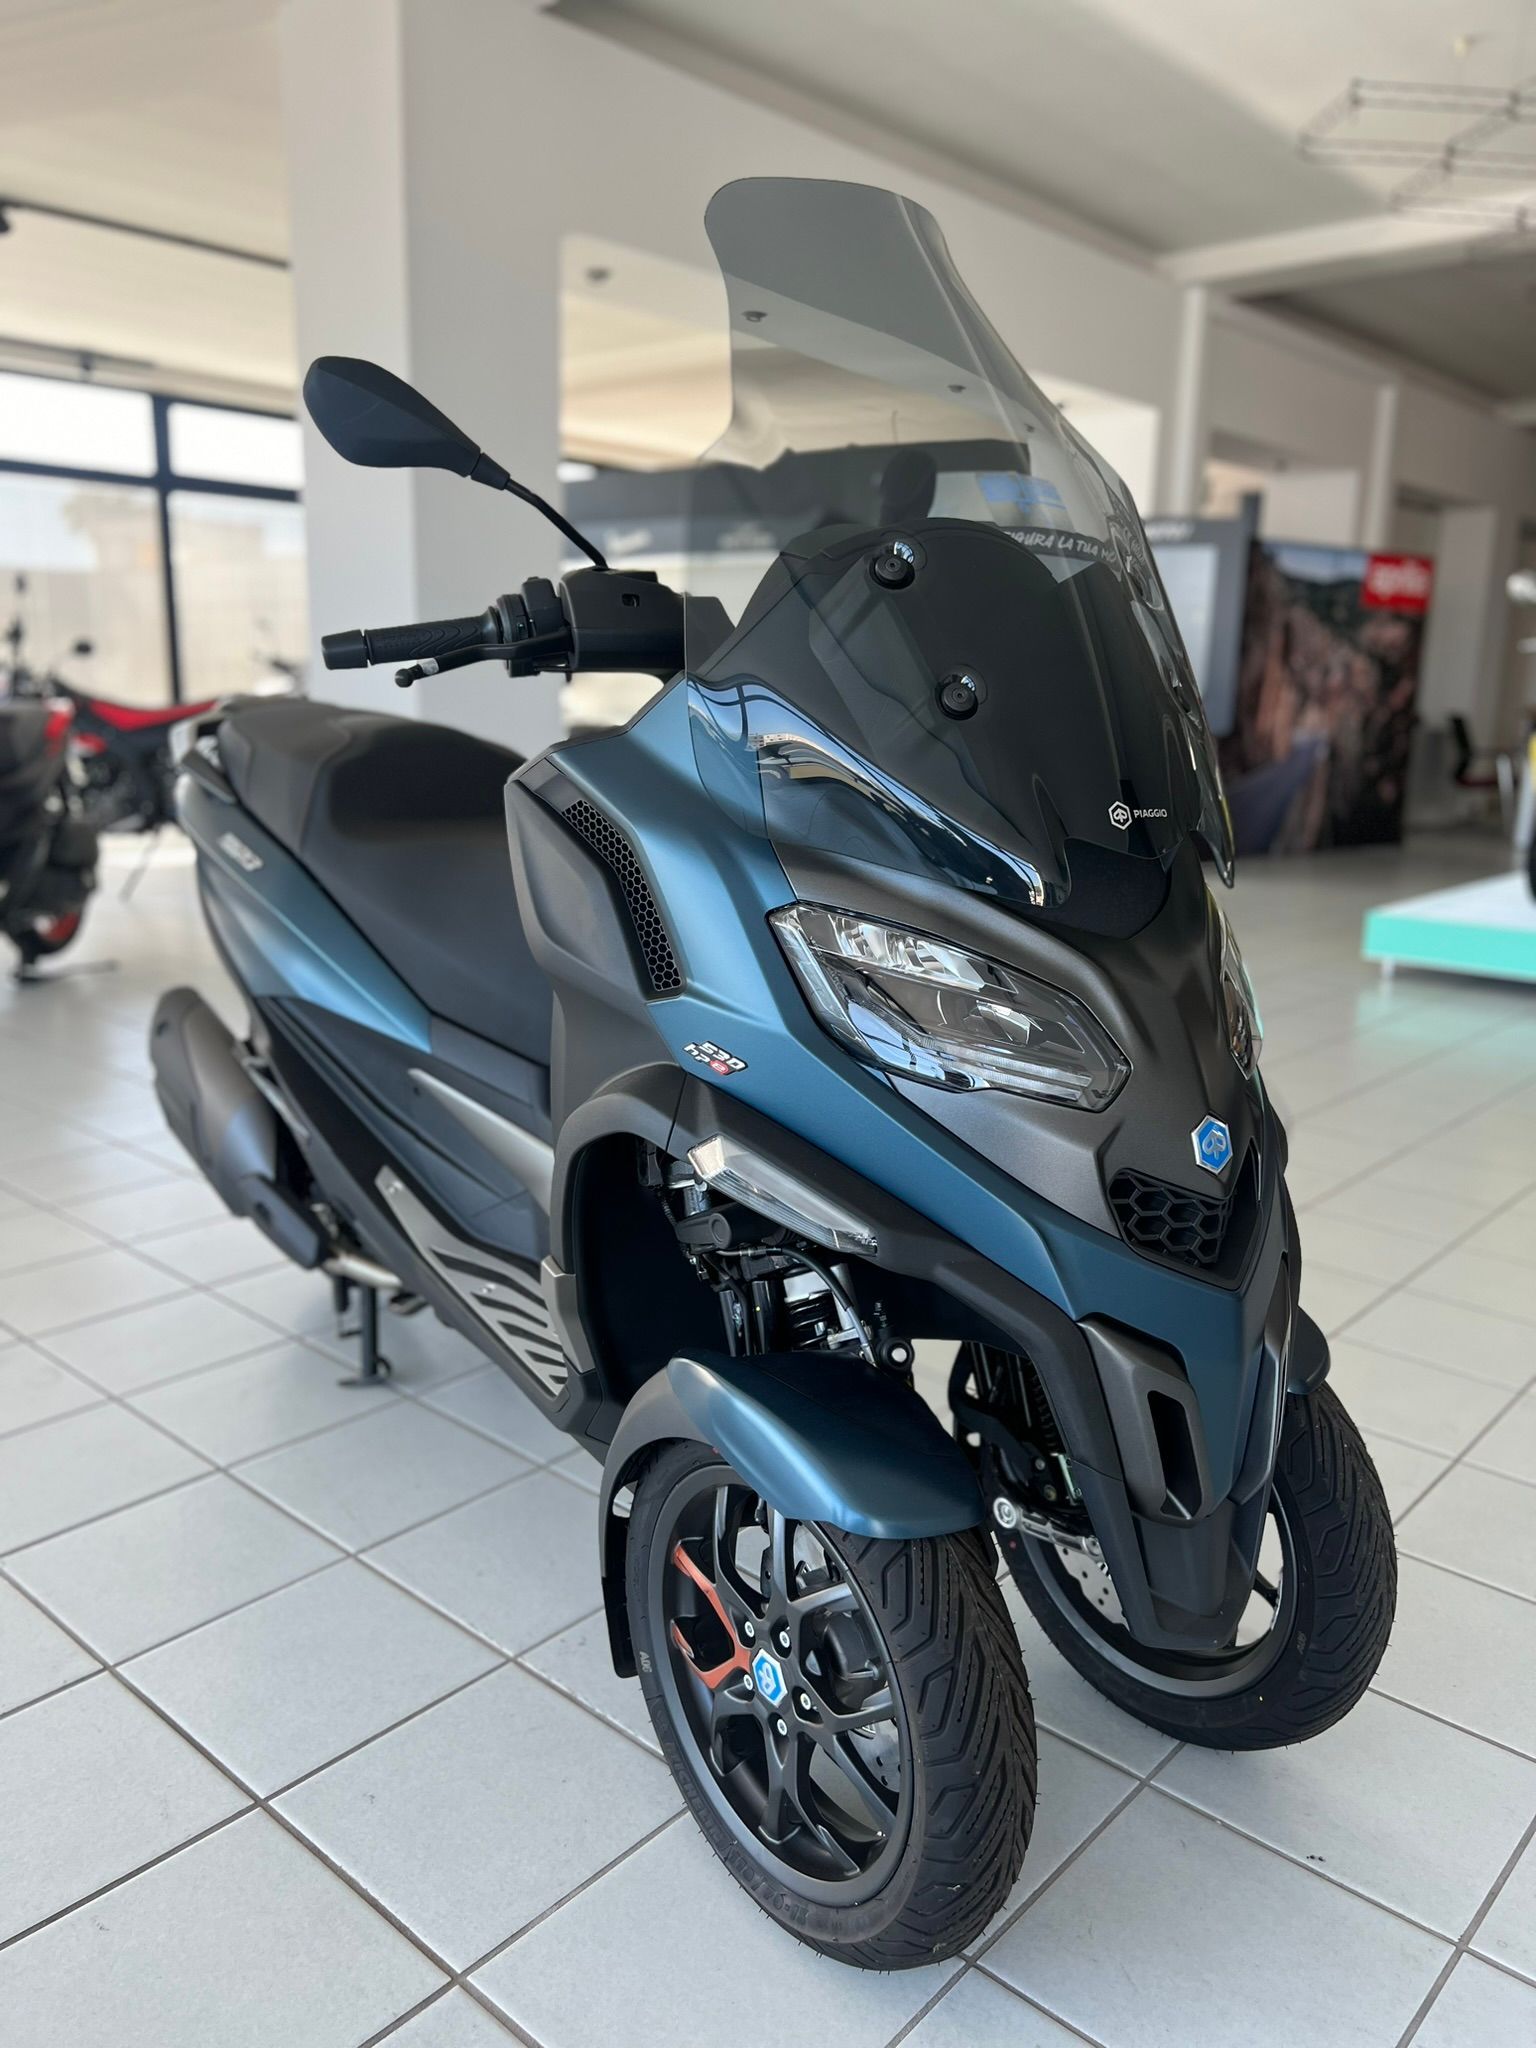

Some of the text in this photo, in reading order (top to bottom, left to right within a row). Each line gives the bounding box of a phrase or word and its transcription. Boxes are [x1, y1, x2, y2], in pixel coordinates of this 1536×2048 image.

[1057, 536, 1075, 550] LA
[1076, 540, 1098, 557] TUA
[1133, 808, 1168, 818] PIAGGIO
[698, 1042, 746, 1070] 530
